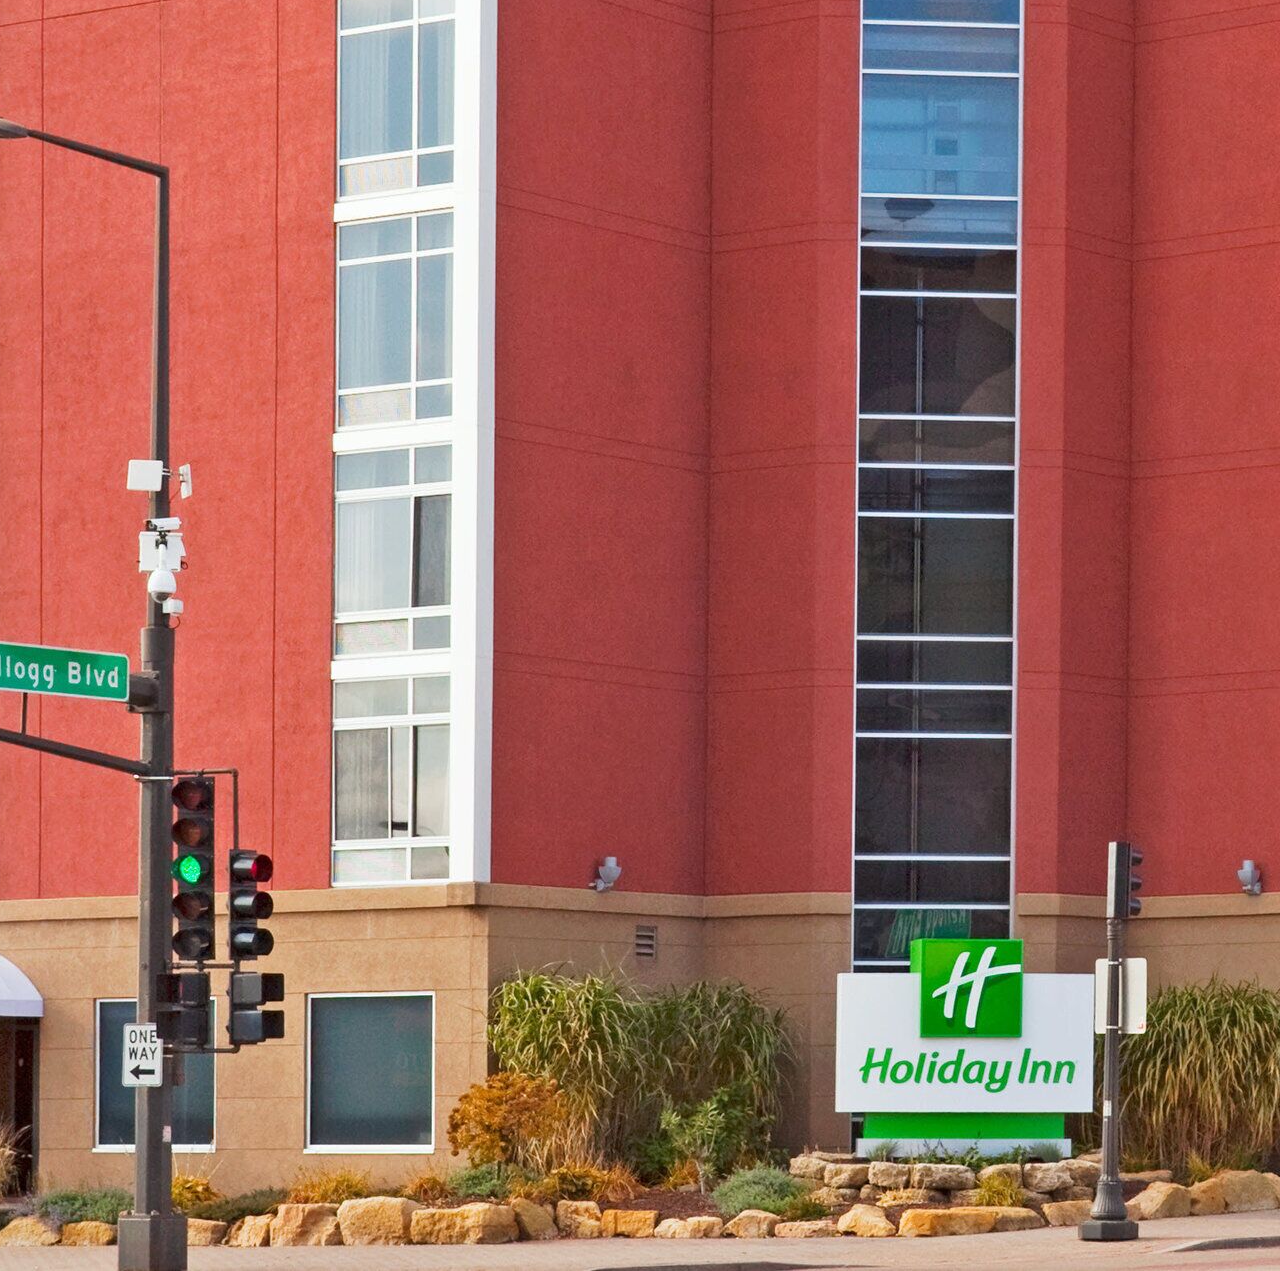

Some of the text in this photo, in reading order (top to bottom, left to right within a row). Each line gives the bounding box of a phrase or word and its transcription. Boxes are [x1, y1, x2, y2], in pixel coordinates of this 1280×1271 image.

[68, 661, 119, 688] Blvd
[129, 1029, 157, 1044] ONE
[128, 1047, 157, 1060] WAY
[859, 1047, 1076, 1093] Holiday Inn
